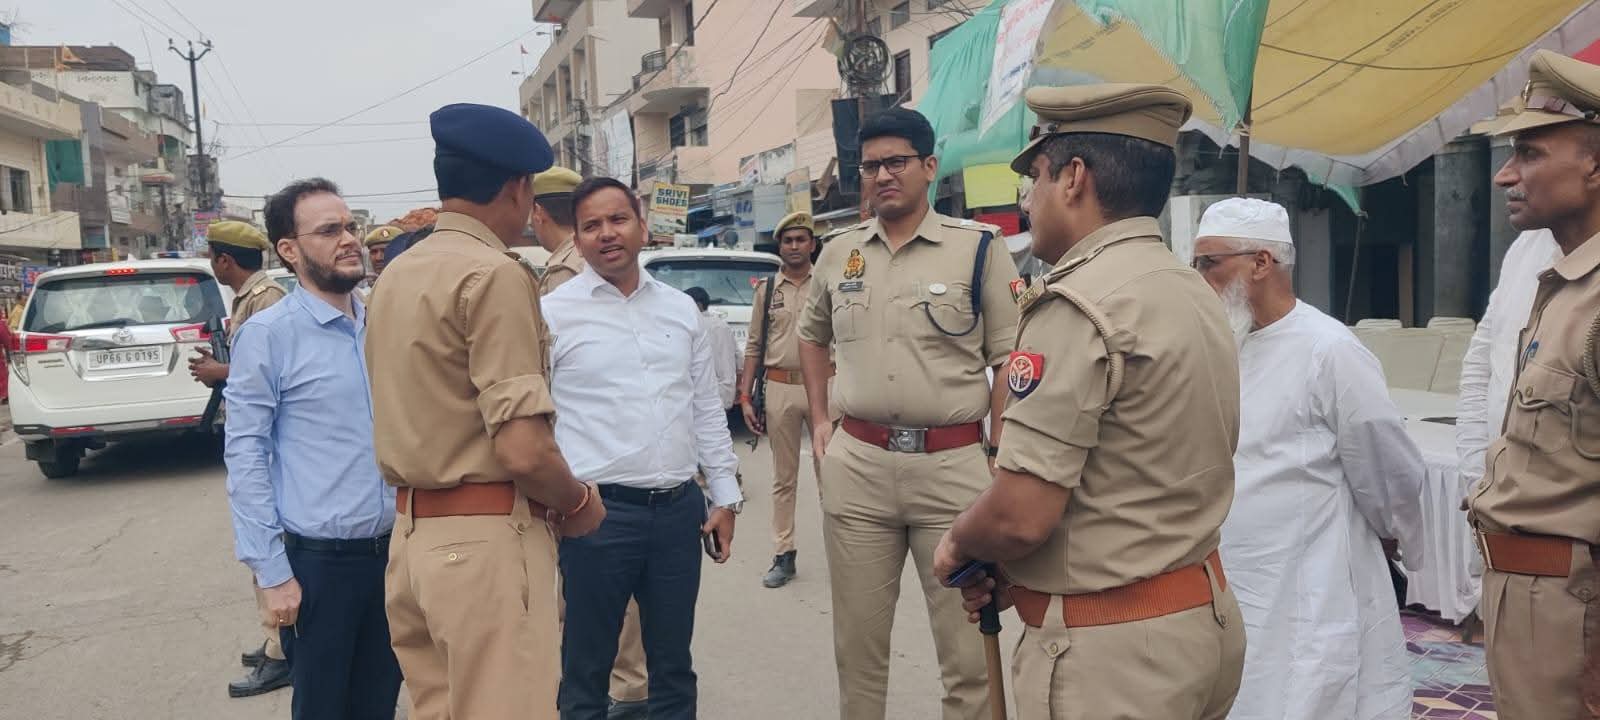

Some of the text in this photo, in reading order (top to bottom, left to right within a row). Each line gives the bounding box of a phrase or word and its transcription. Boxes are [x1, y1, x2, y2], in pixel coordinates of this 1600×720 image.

[656, 197, 687, 206] SHOES
[96, 350, 159, 364] UP66 G 0195
